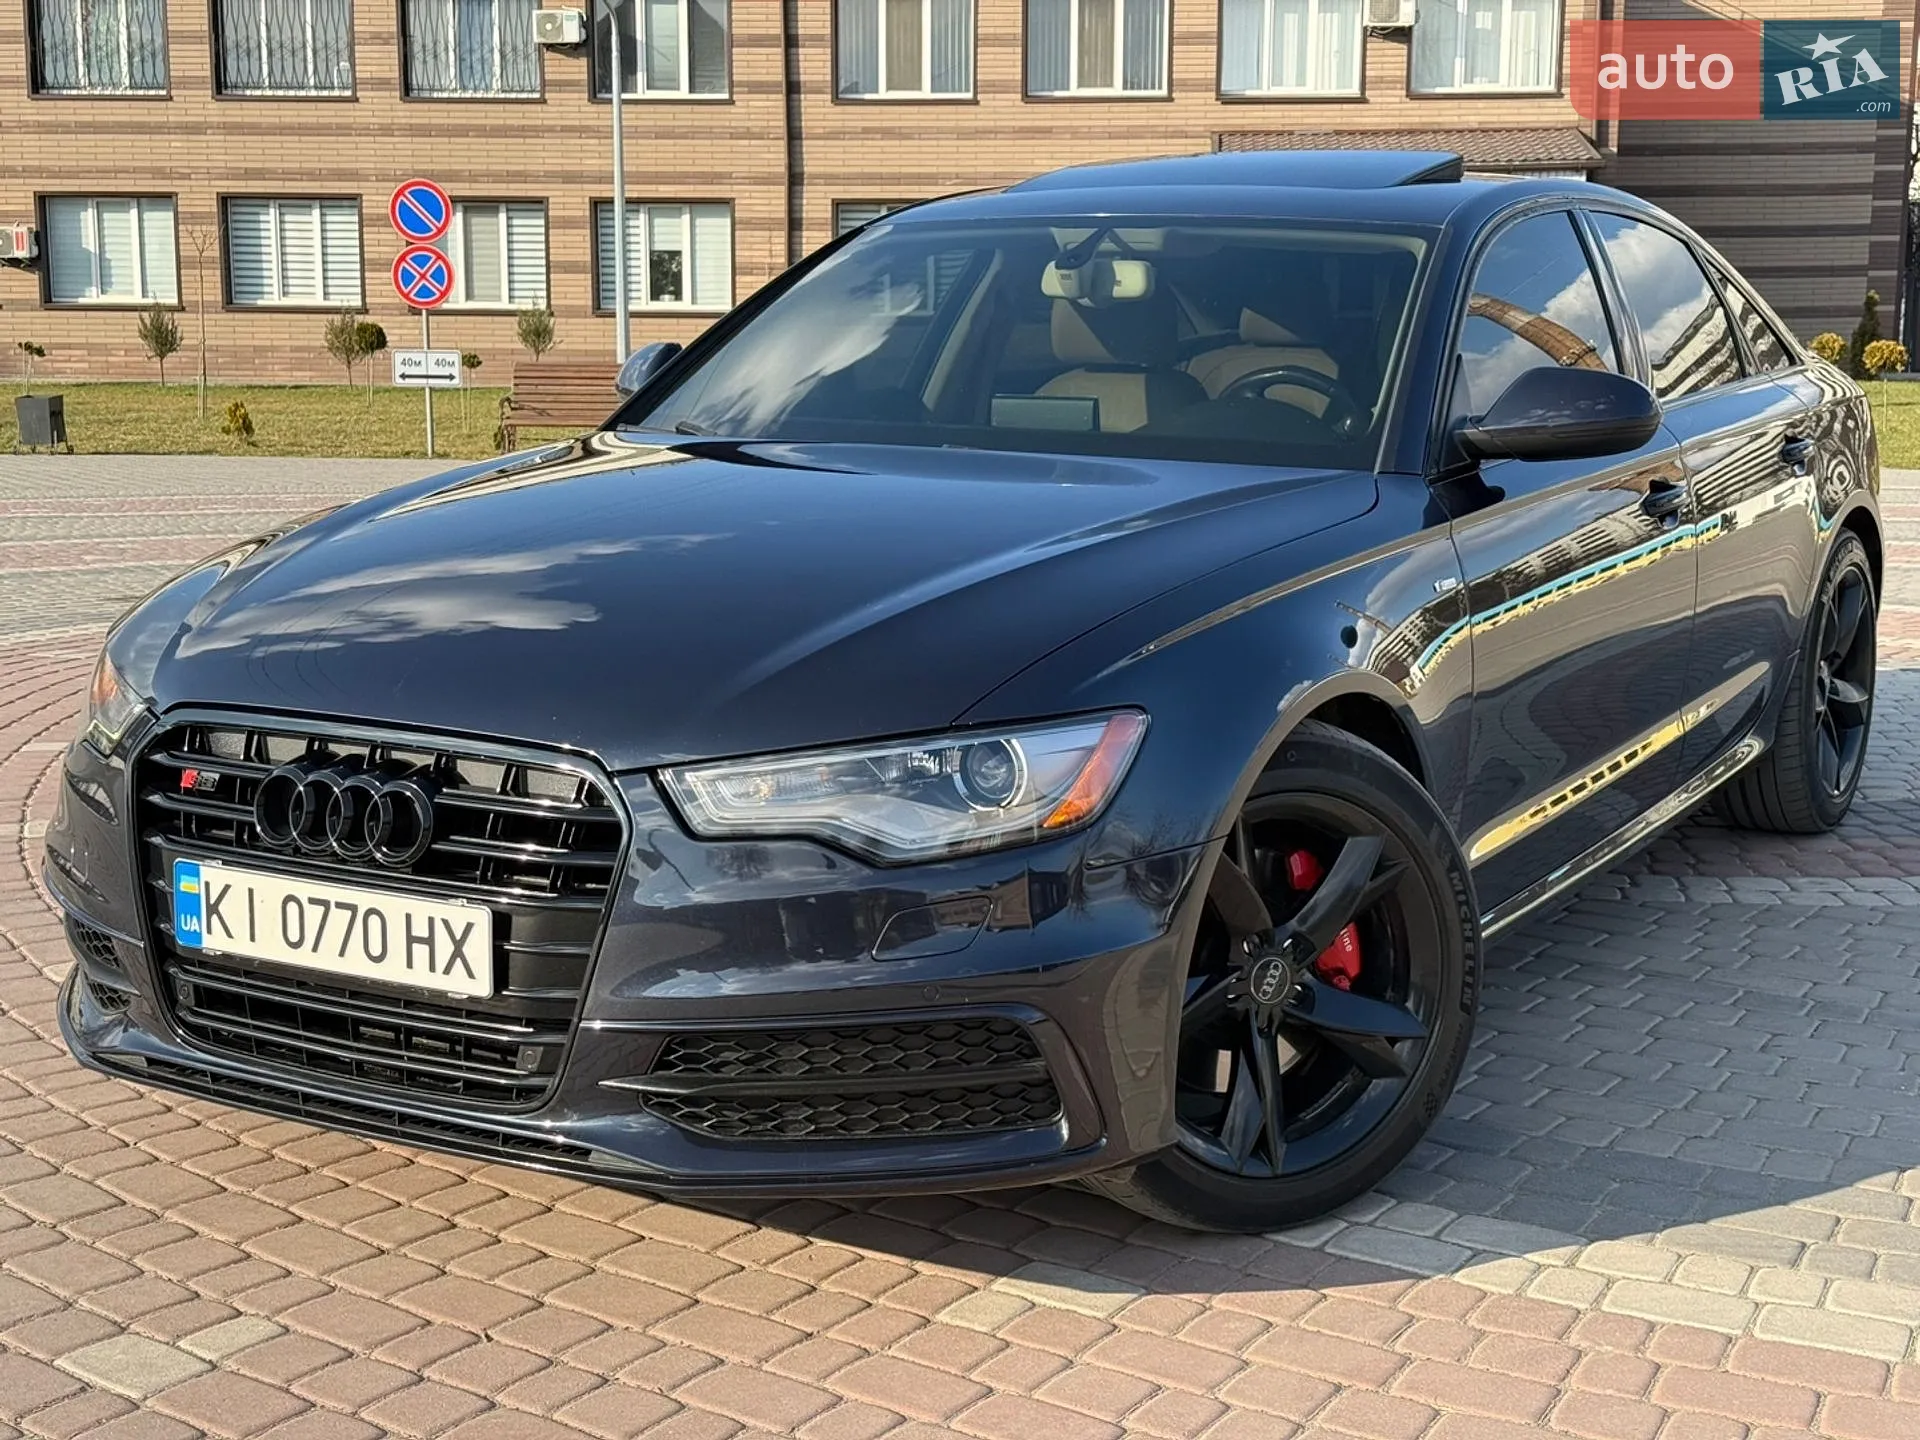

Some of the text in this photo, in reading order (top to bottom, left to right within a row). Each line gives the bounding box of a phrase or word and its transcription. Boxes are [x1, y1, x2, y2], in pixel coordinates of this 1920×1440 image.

[181, 914, 200, 932] UA
[204, 880, 477, 980] KI 0770 HX
[1449, 870, 1477, 1009] MICHELIN
